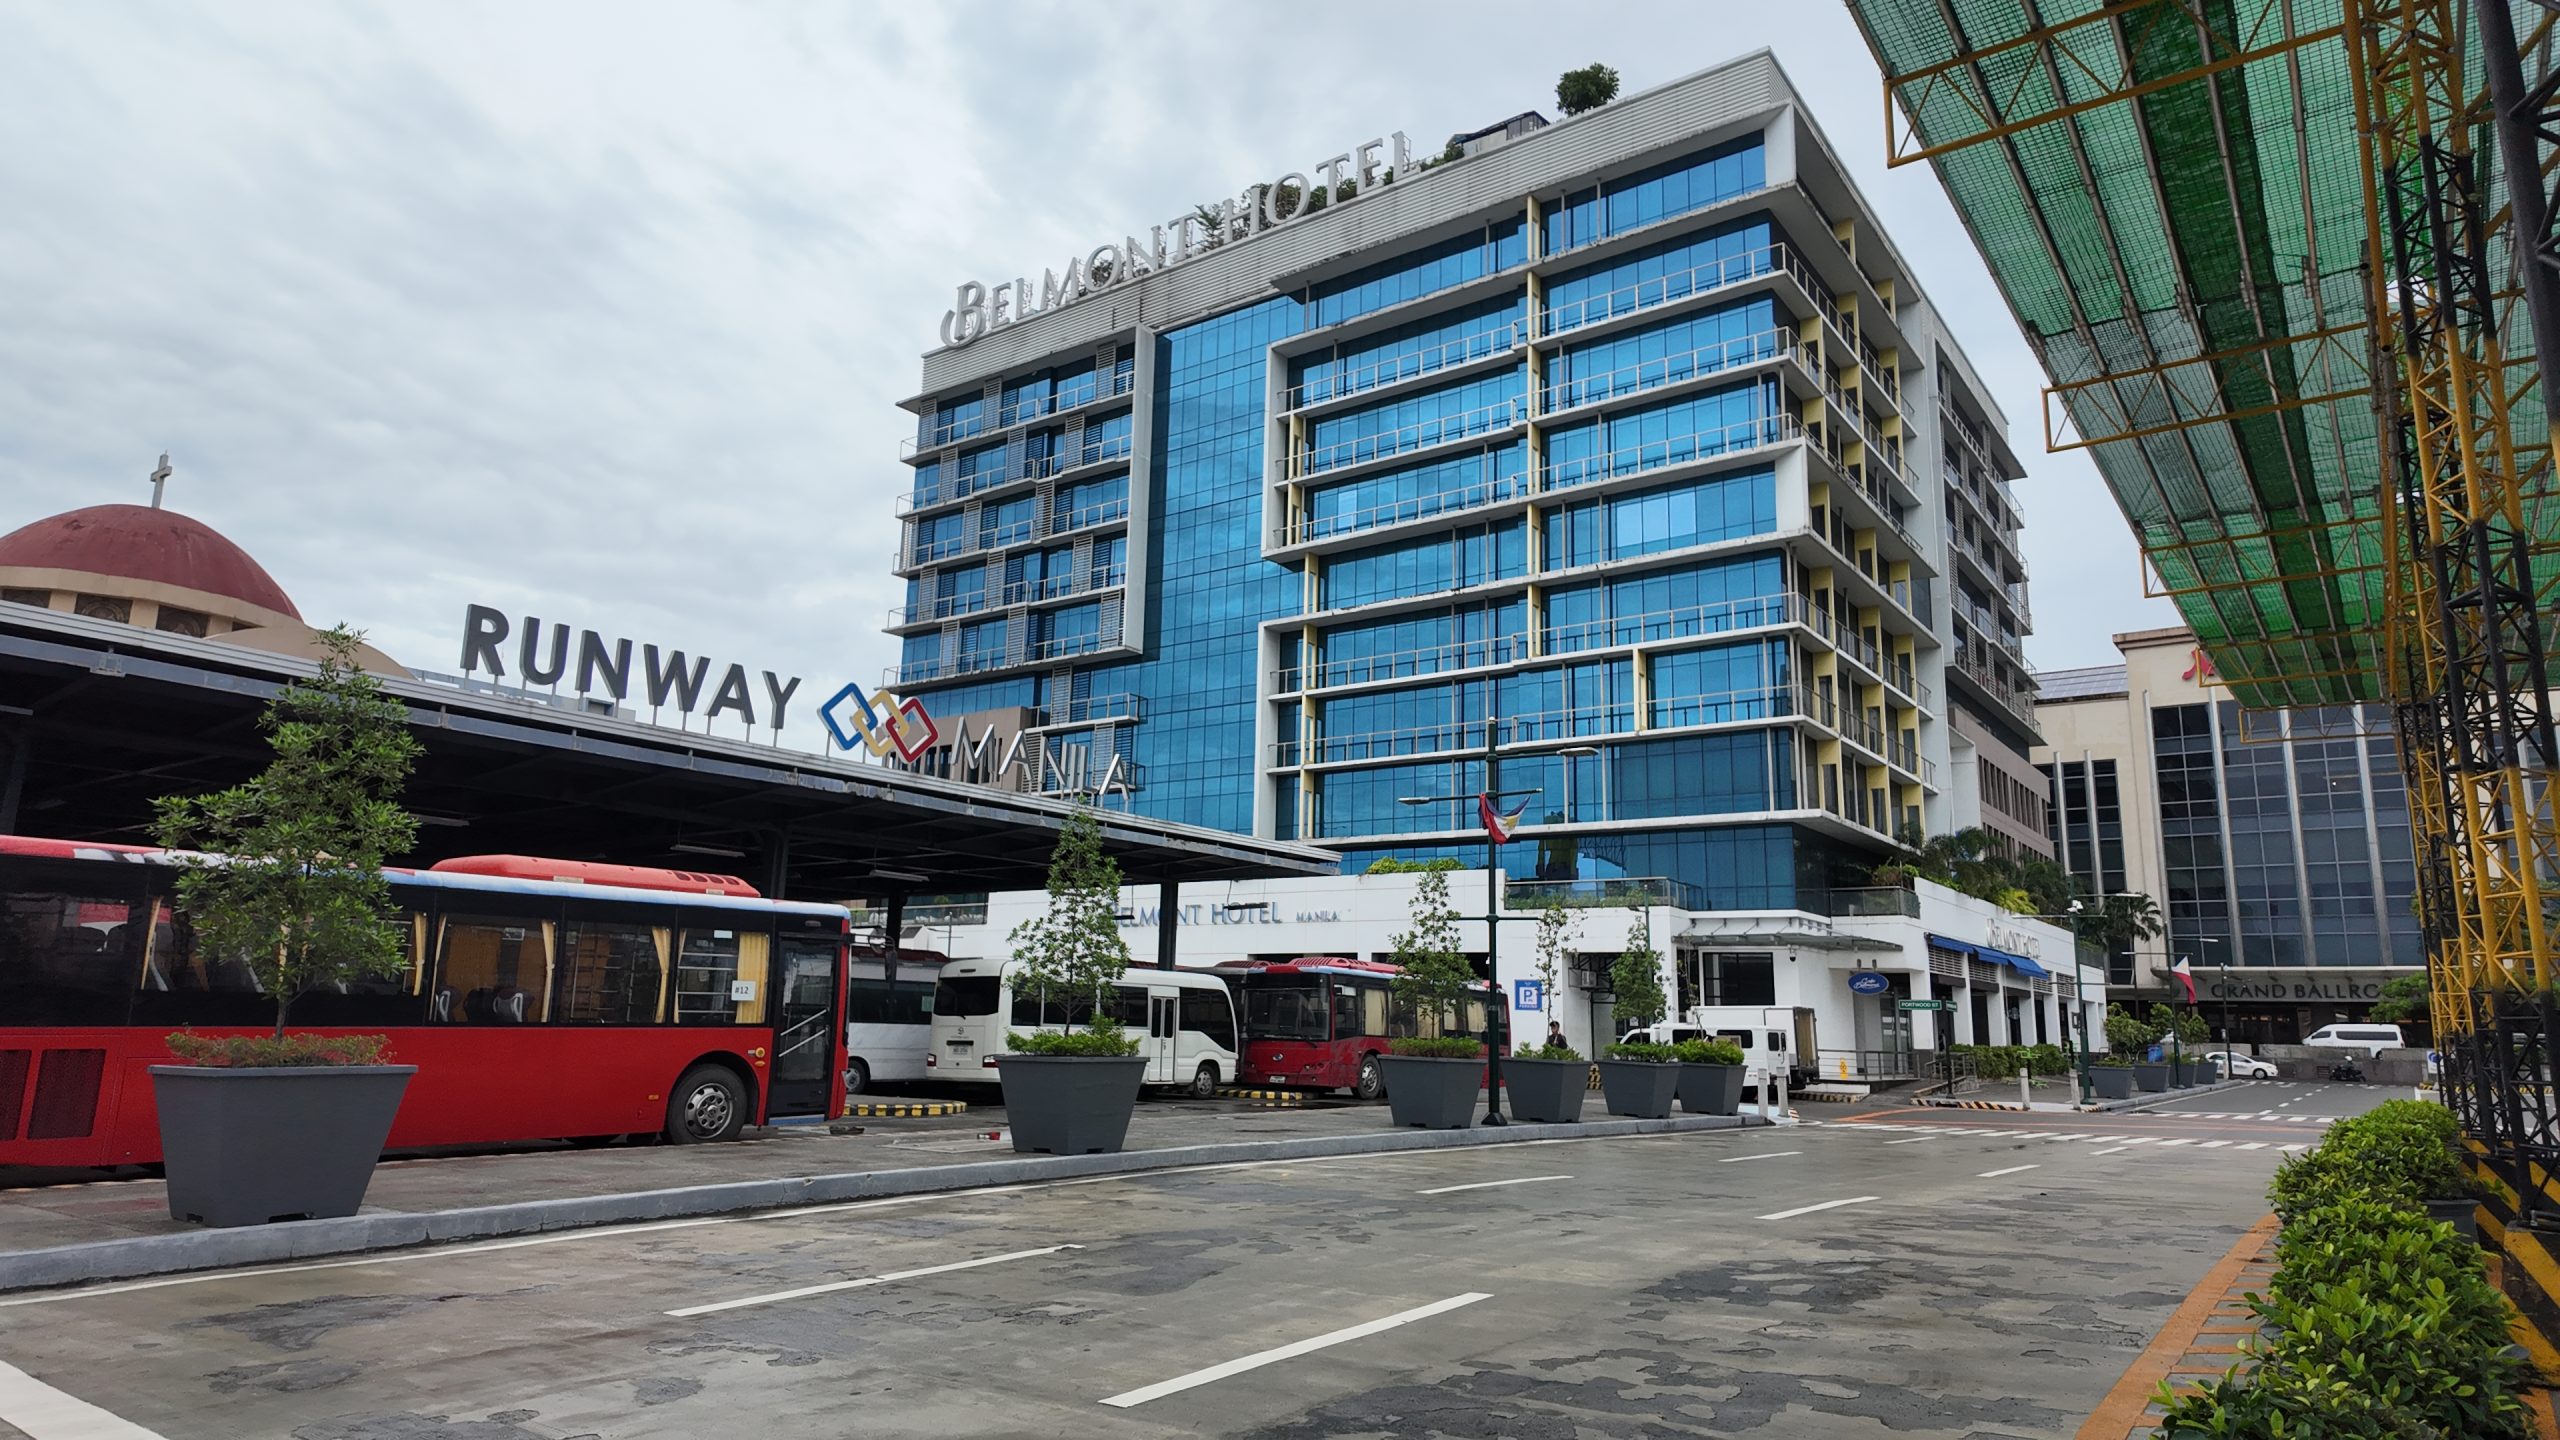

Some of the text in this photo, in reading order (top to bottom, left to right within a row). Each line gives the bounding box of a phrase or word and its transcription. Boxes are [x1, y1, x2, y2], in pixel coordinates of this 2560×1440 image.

[940, 130, 1421, 348] BELMONT HOTEL
[460, 603, 1131, 801] RUNWAY MANILA
[1211, 901, 1282, 925] HOTEL
[735, 986, 749, 994] #12
[1524, 989, 1533, 1003] P
